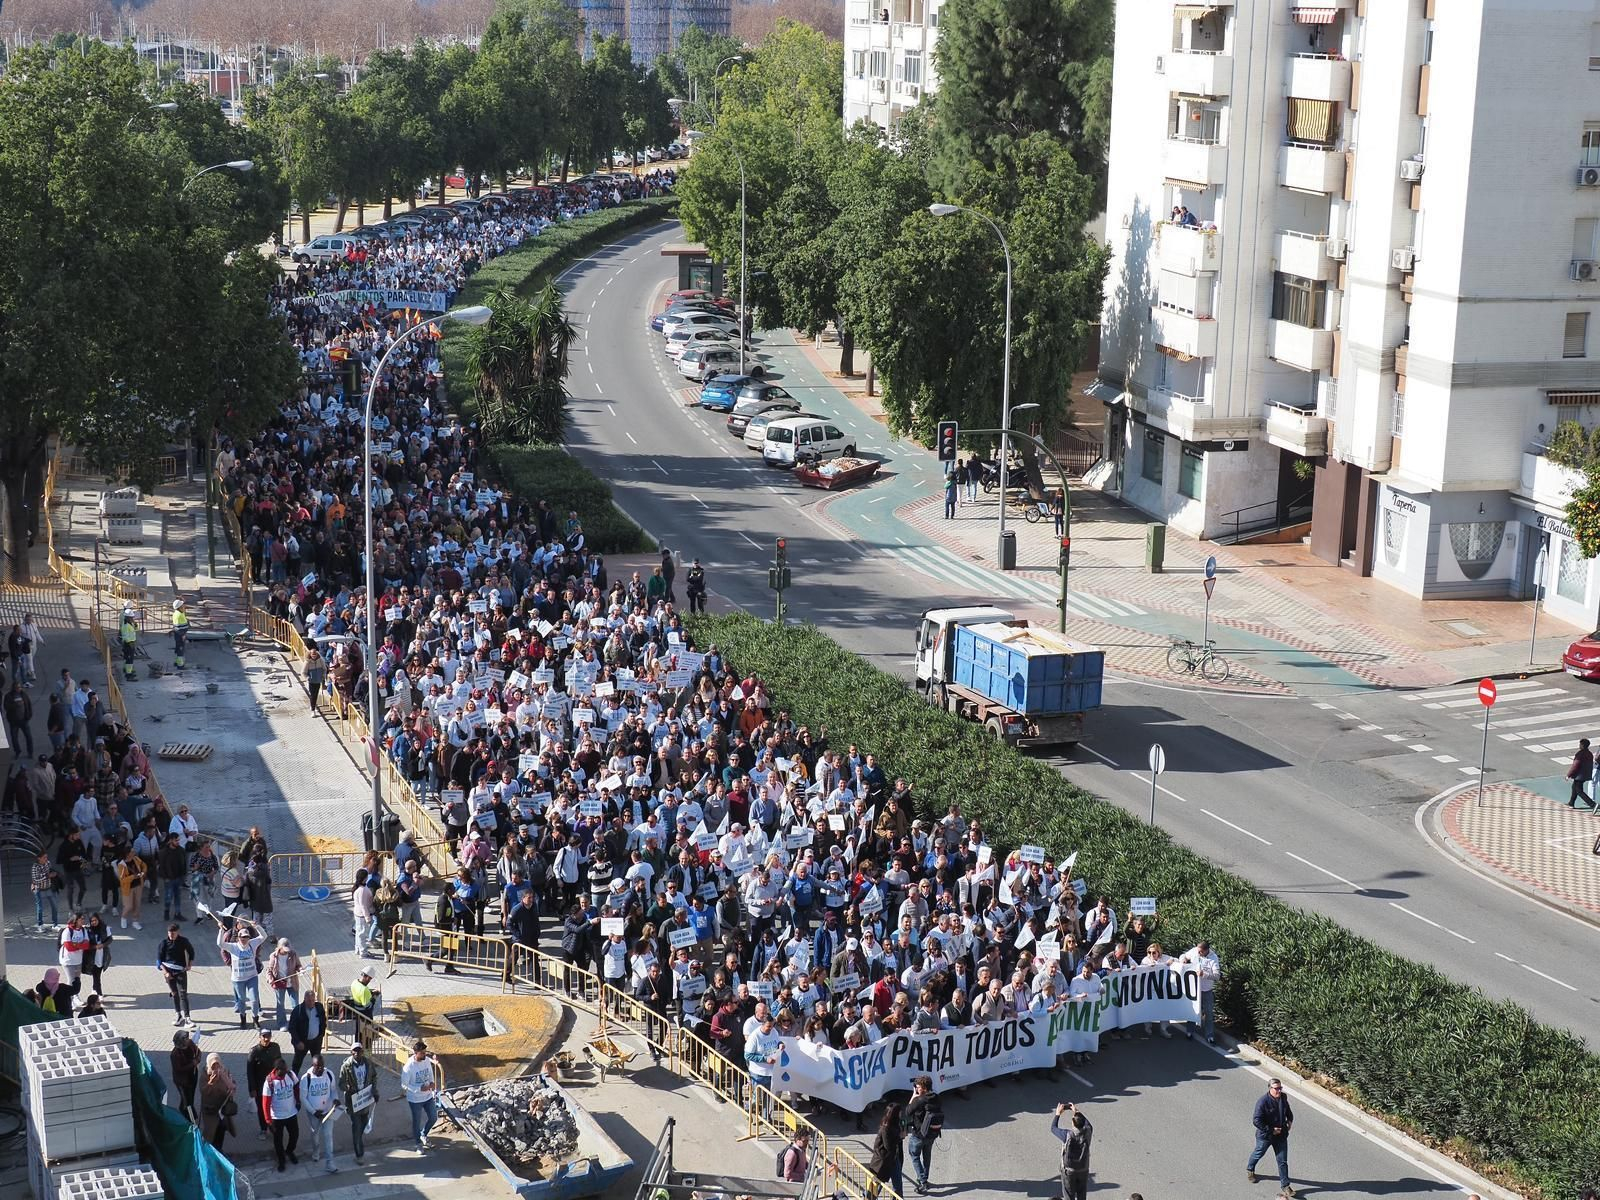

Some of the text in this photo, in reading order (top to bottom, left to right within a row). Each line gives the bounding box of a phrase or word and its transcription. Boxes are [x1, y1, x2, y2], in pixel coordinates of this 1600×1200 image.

[388, 291, 408, 303] PARA
[1537, 516, 1548, 528] El
[834, 1045, 887, 1091] AGUA
[891, 1035, 955, 1073] PARA
[965, 1017, 1035, 1065] TODOS
